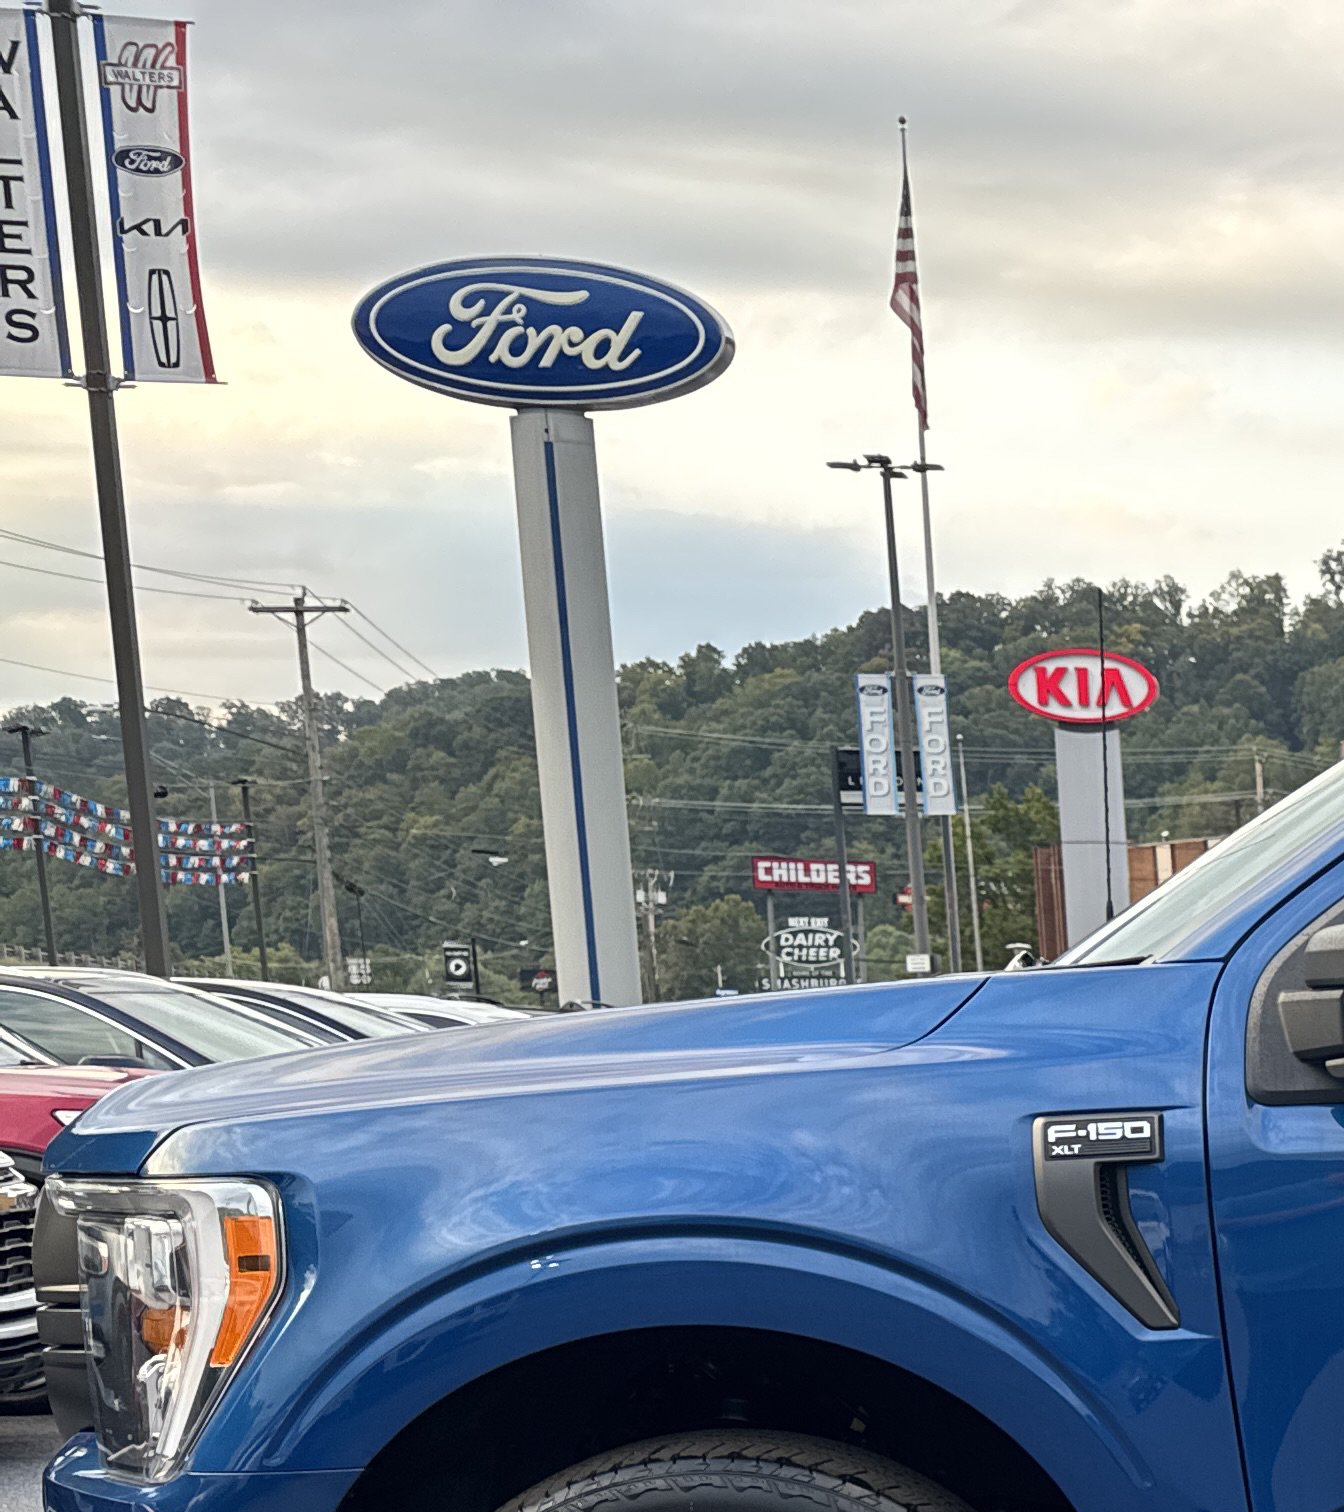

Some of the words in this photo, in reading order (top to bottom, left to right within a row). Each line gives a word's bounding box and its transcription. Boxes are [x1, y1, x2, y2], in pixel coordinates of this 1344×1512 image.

[112, 68, 175, 84] WALTERS
[124, 150, 172, 173] Ford
[430, 281, 645, 373] Ford
[1034, 666, 1133, 708] KIA
[865, 706, 890, 798] FORD
[923, 706, 950, 799] FORD
[757, 861, 872, 886] CHILDERS
[780, 933, 838, 947] DAIRY
[781, 947, 841, 961] CHEER
[1047, 1120, 1151, 1143] F-150
[1051, 1143, 1083, 1155] XLT
